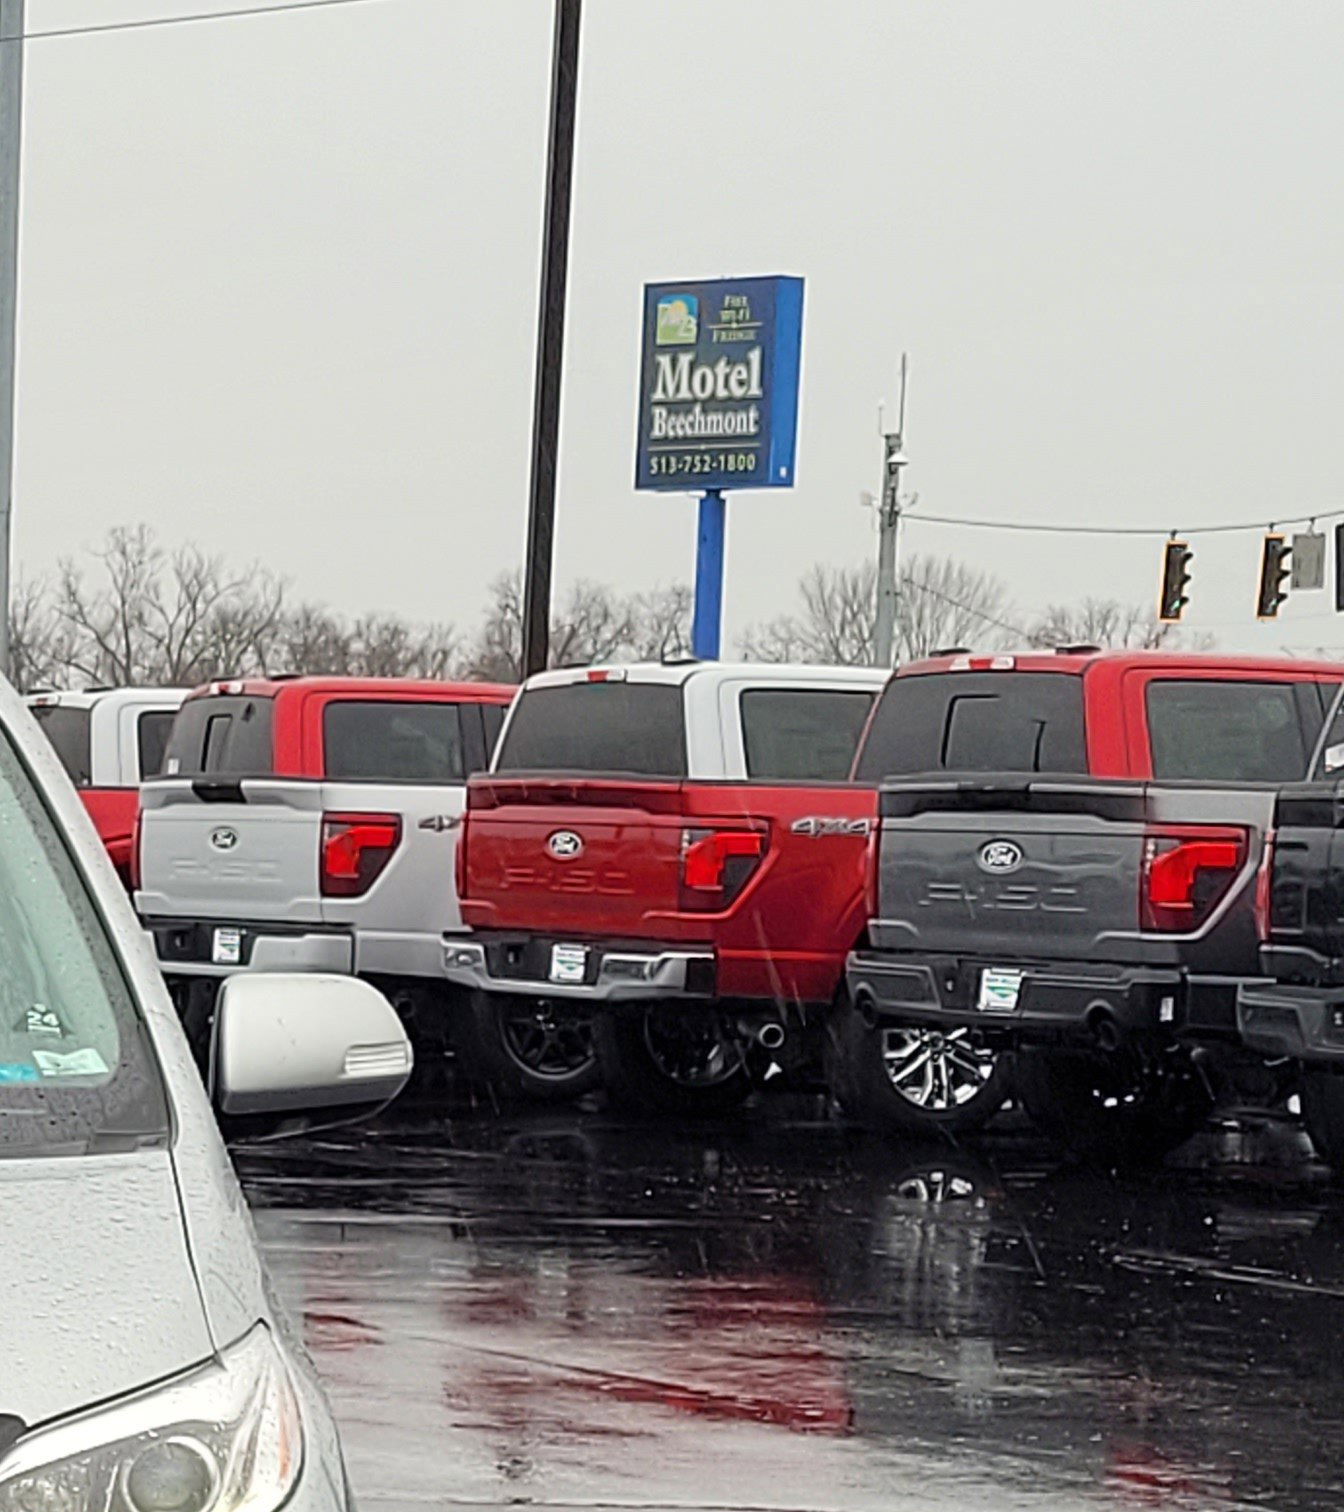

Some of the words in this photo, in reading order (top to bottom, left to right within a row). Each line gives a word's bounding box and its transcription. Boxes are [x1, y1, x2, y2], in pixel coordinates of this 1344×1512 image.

[651, 346, 763, 401] Motel
[650, 402, 759, 439] Beechmont
[650, 453, 756, 475] 513-752-1800
